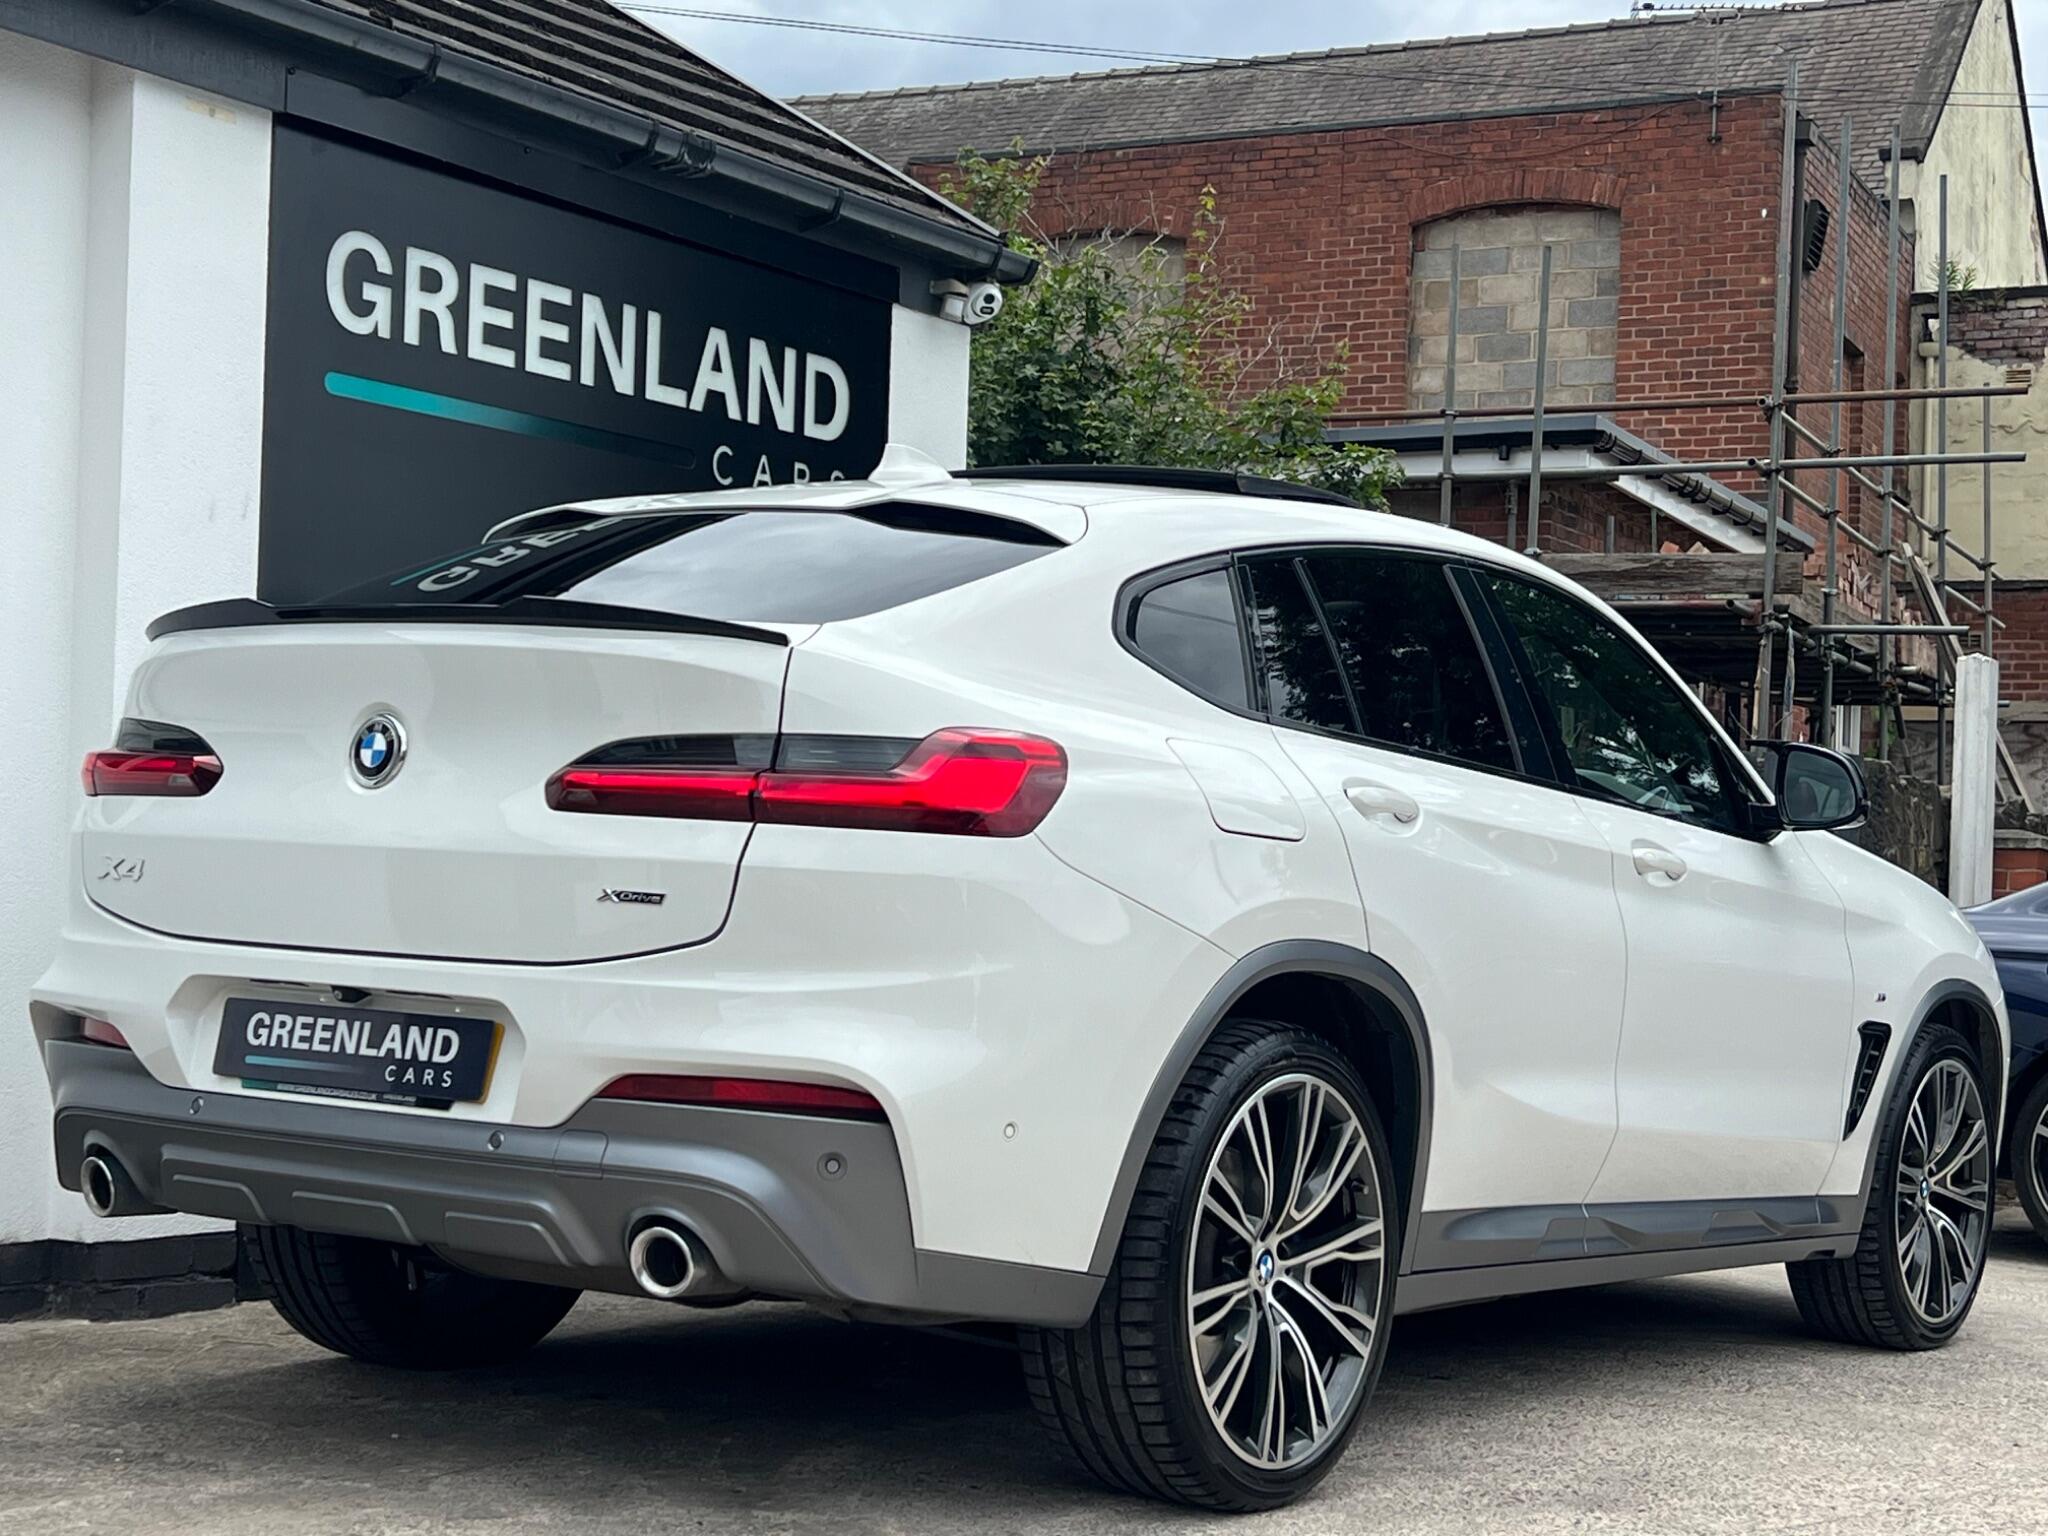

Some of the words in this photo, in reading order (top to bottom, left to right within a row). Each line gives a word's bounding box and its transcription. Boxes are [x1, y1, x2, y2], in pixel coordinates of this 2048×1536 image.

[325, 230, 851, 442] GREENLAND
[98, 856, 145, 882] X4
[246, 1011, 460, 1064] GREENLAND
[384, 1065, 453, 1088] CARS
